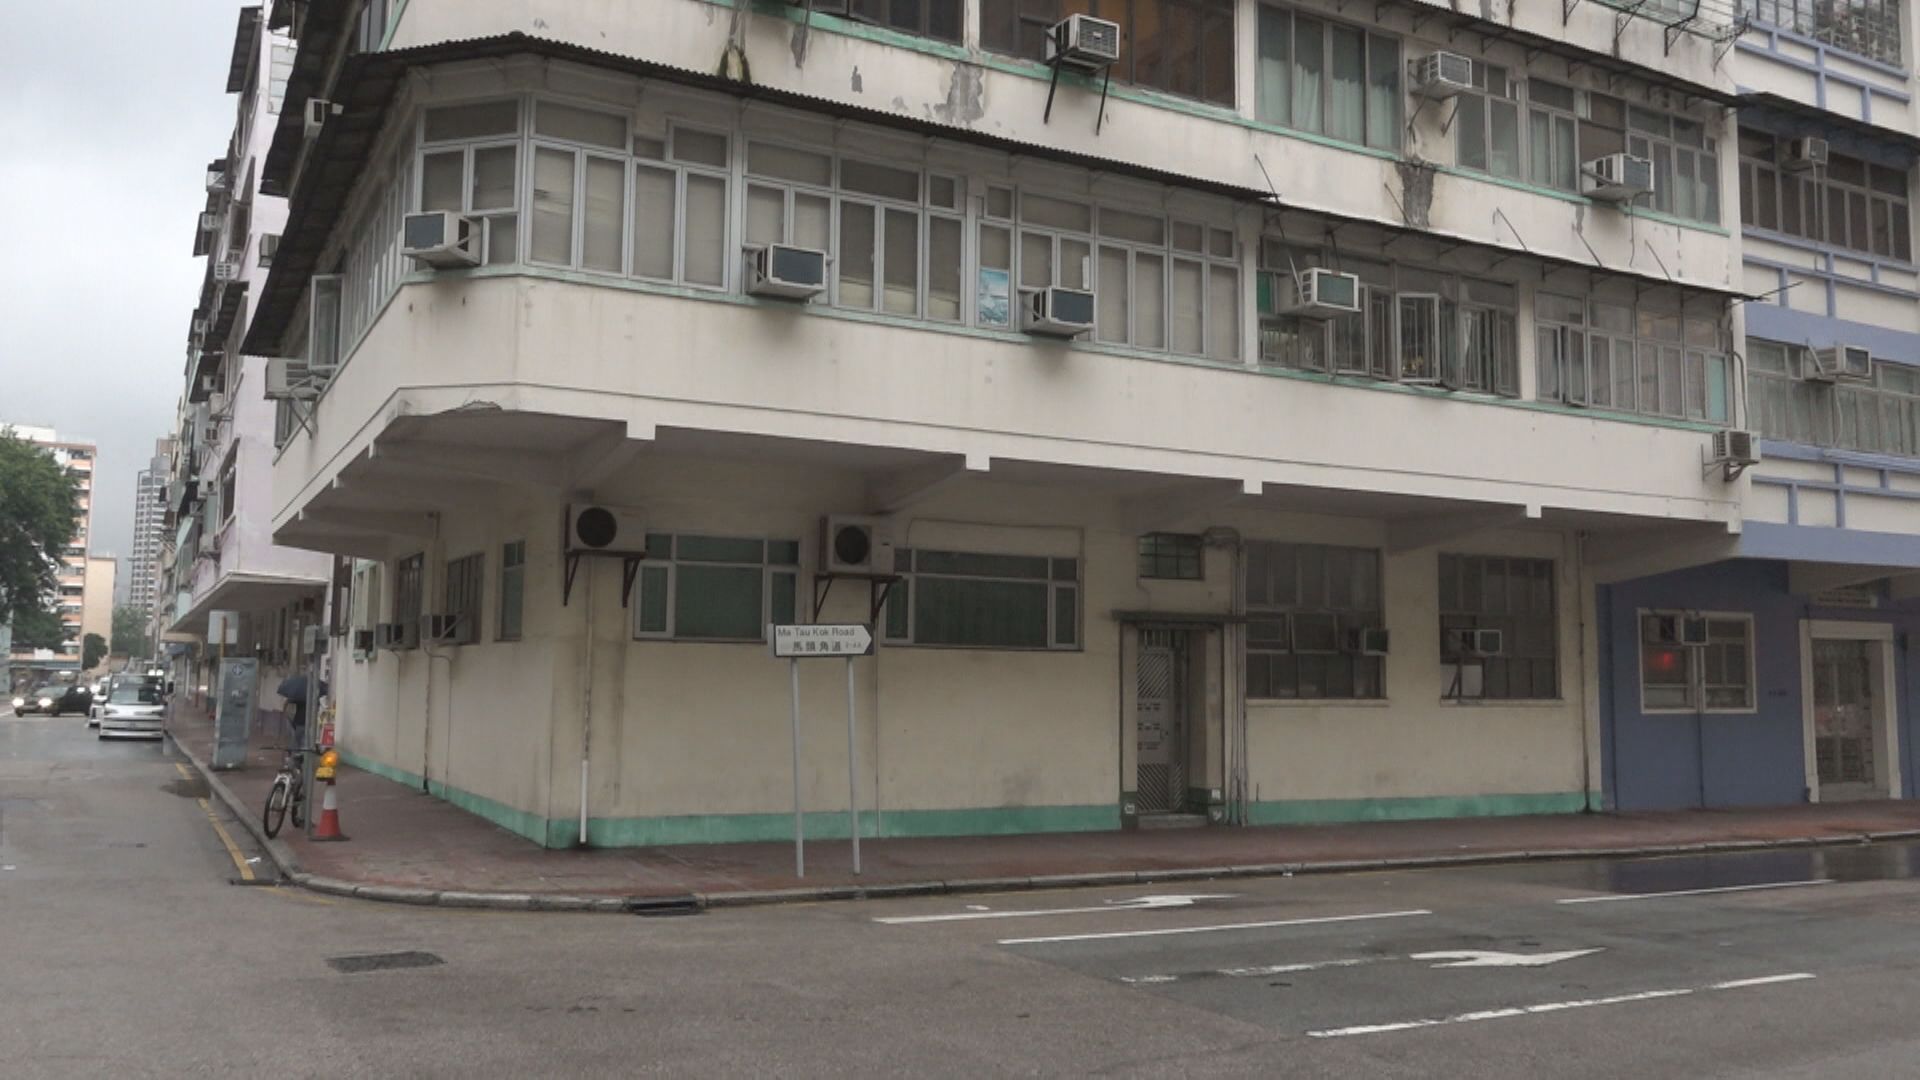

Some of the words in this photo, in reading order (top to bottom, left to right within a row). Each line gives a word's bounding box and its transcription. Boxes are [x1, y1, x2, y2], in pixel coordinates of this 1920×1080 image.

[777, 627, 791, 636] Ma
[795, 627, 811, 636] Tau
[813, 627, 829, 636] Kok
[832, 627, 855, 636] Road
[793, 641, 841, 652] 馬頭角道
